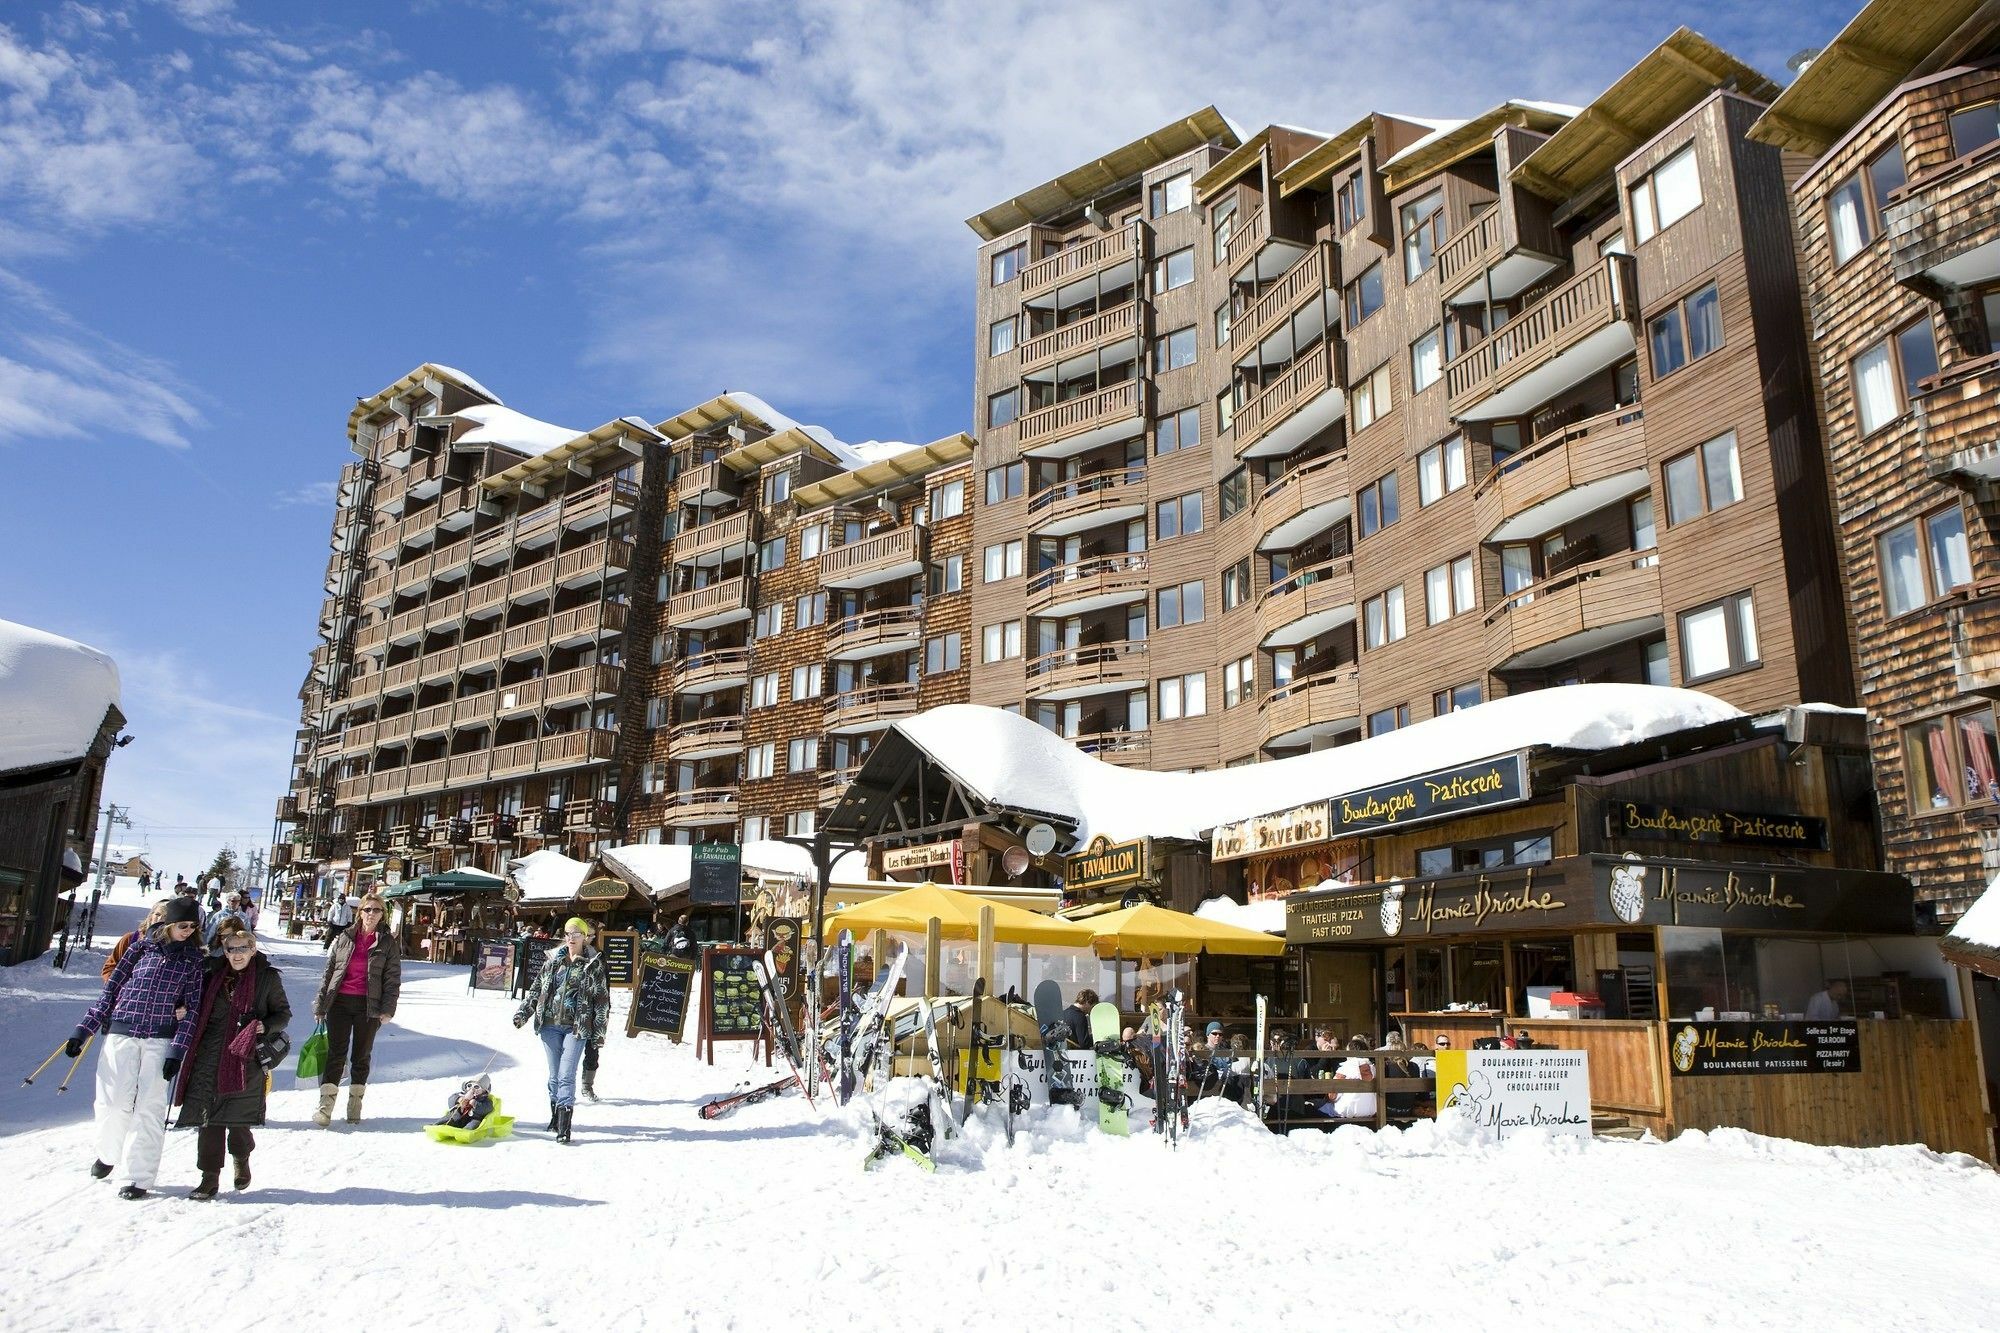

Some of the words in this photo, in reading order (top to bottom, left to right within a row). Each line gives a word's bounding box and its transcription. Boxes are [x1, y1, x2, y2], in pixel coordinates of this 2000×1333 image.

[1342, 789, 1416, 824] Boulangerie
[1425, 768, 1503, 803] Patisserie
[1626, 803, 1723, 840] Boulangerie
[1725, 813, 1806, 840] Patisserie
[702, 852, 736, 861] TAVAILLON
[716, 846, 729, 854] Pub
[888, 857, 899, 868] Les
[930, 847, 951, 863] Blanch
[1069, 862, 1080, 881] LE
[1082, 850, 1134, 879] TAVAILLON
[1287, 899, 1335, 914] BOULANGERIE
[1336, 893, 1381, 909] PATISSERIE
[1410, 882, 1475, 934] Mamie
[1475, 867, 1566, 926] Brioche
[1653, 867, 1723, 926] Mamie
[1724, 871, 1805, 913] Brioche
[1301, 912, 1337, 925] TRAITEUR
[1340, 910, 1364, 922] PIZZA
[1312, 927, 1329, 938] FAST
[1331, 925, 1352, 936] FOOD
[644, 956, 658, 964] Avo
[666, 959, 693, 971] Saveurs
[1829, 1026, 1839, 1034] 1er
[1699, 1028, 1748, 1058] Mamie
[1752, 1028, 1807, 1052] Brioche
[1816, 1050, 1832, 1058] PIZZA
[1832, 1050, 1850, 1058] PARTY
[1482, 1058, 1533, 1067] BOULANGERIE
[1540, 1058, 1581, 1067] PATISSERIE
[1703, 1060, 1760, 1069] BOULANGERIE
[1765, 1060, 1808, 1068] PATISSERIE
[1496, 1070, 1531, 1079] CREPERIE
[1538, 1070, 1569, 1079] GLACIER
[1507, 1082, 1560, 1091] CHOCOLATERIE
[1530, 1101, 1588, 1127] Brioche
